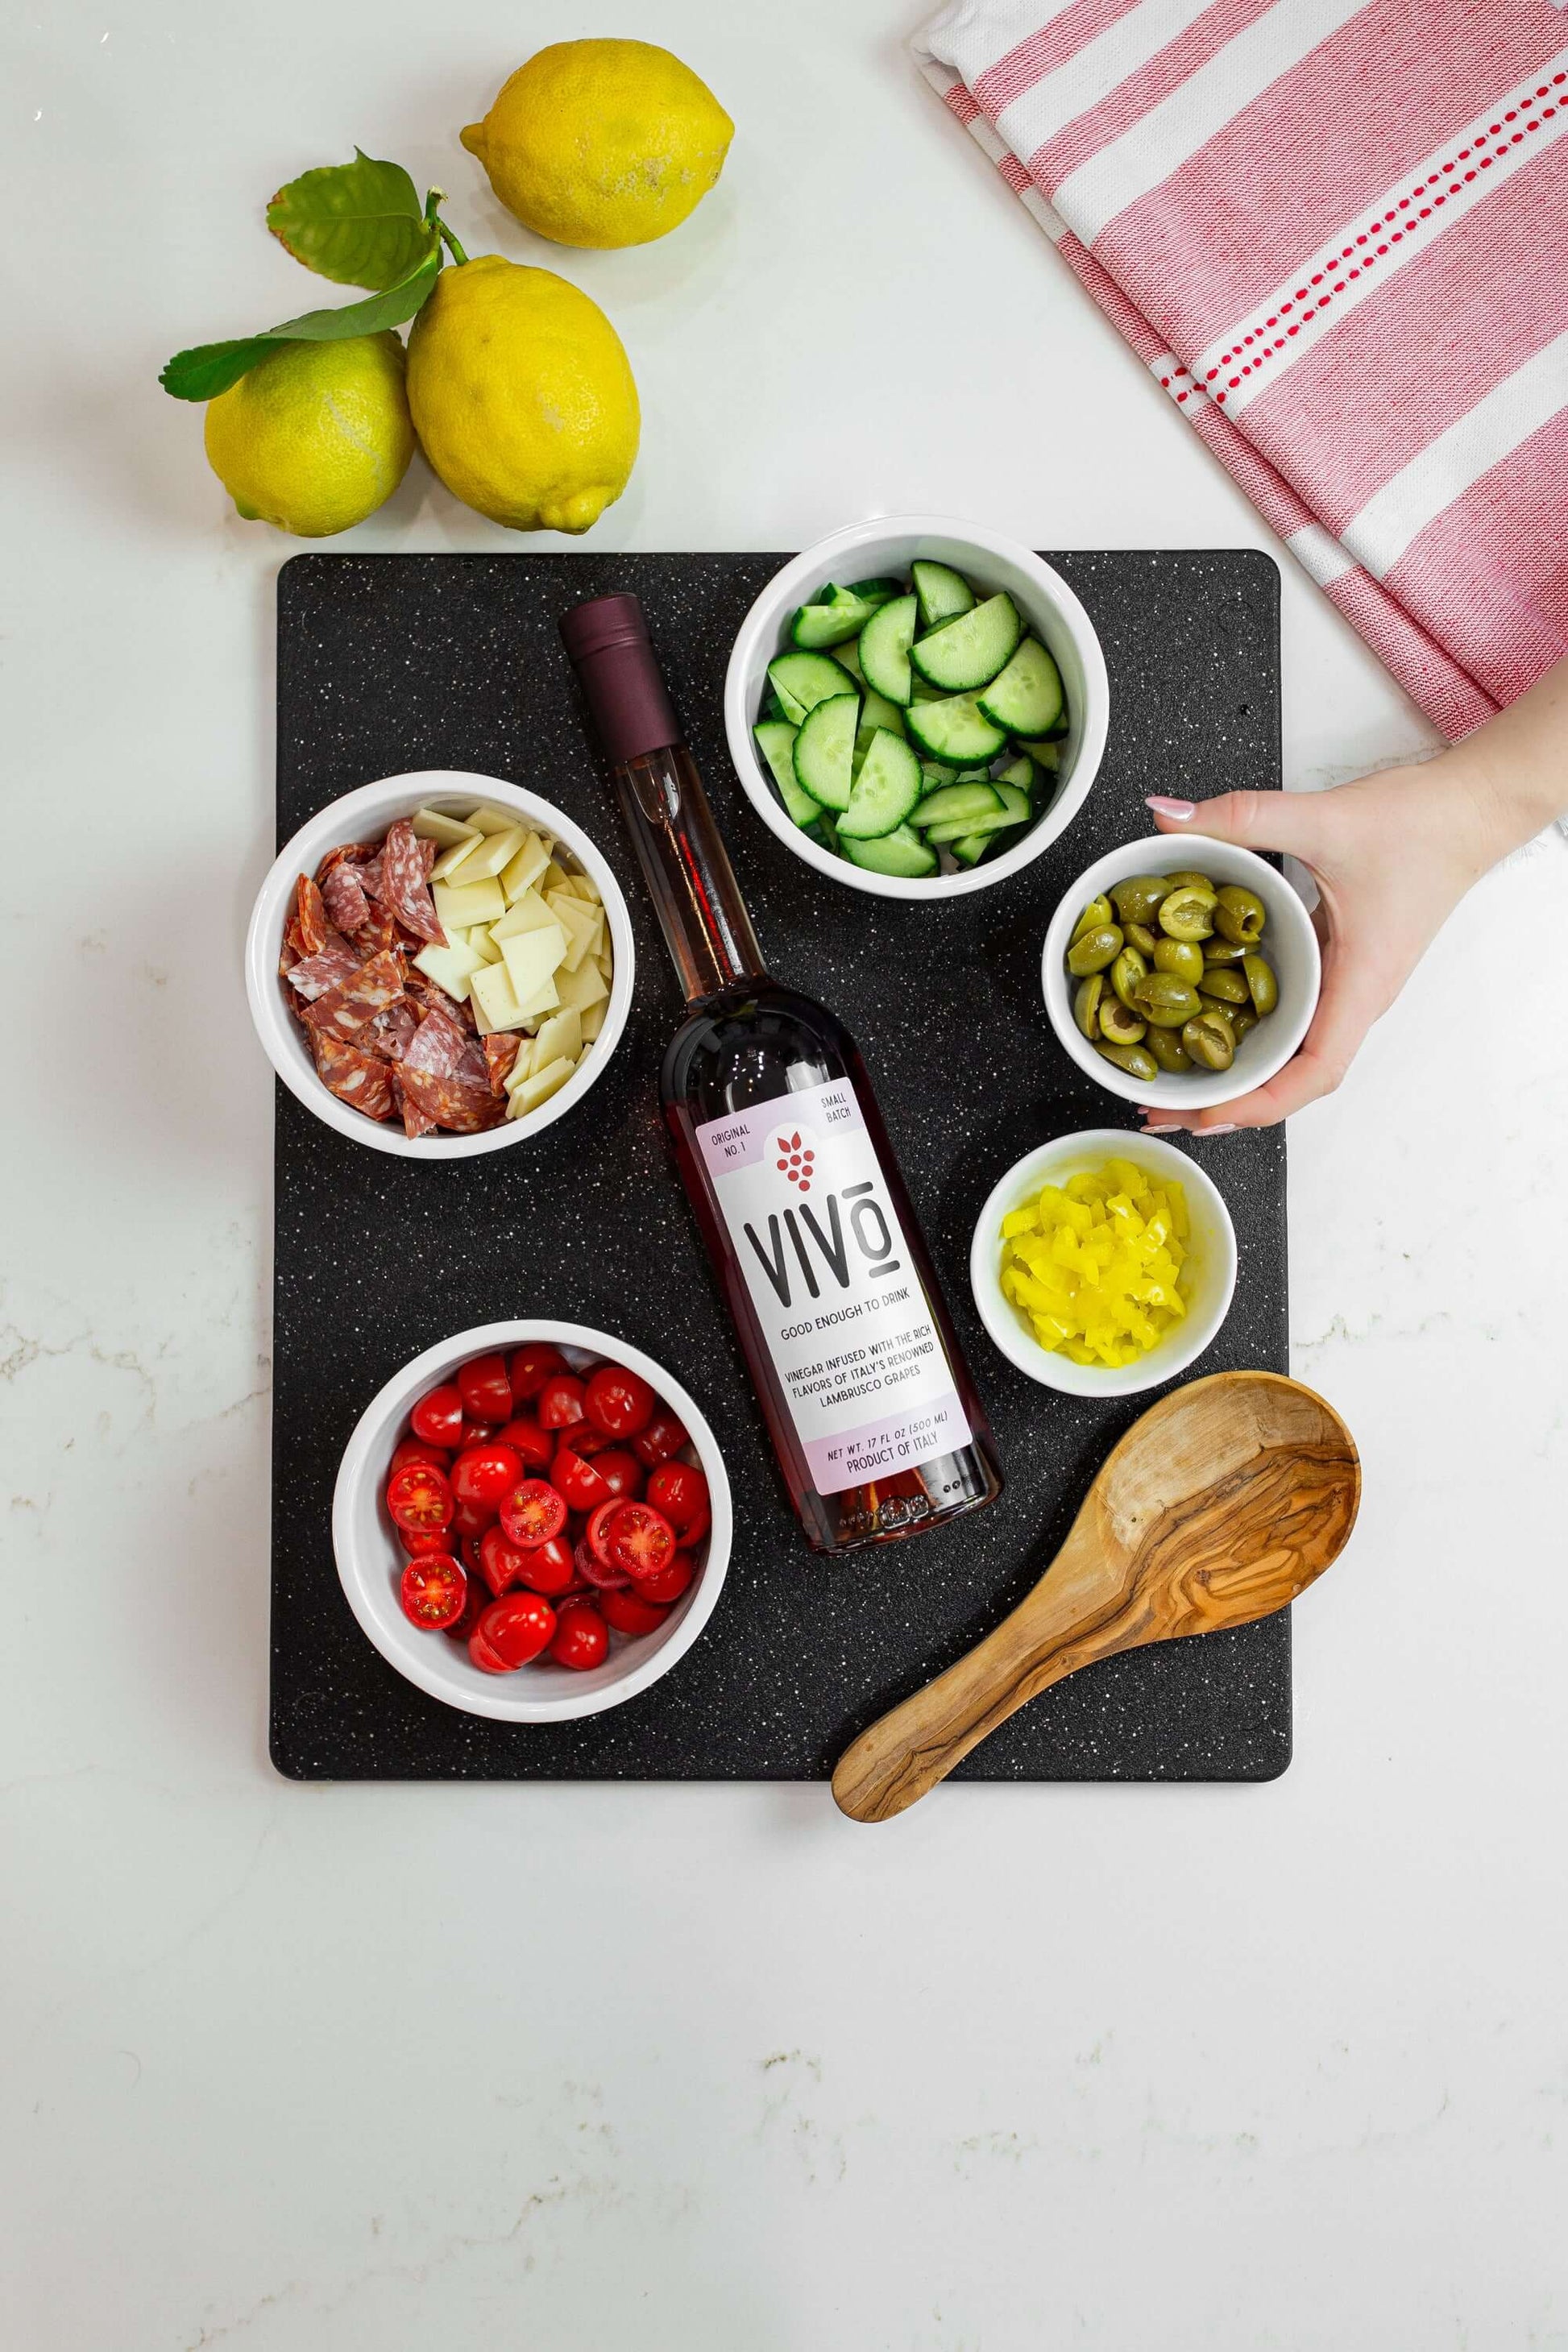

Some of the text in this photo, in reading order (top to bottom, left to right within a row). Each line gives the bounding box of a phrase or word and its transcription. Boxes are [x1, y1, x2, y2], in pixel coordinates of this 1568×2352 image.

[821, 1092, 847, 1109] SMALL
[827, 1106, 852, 1122] BATCH
[711, 1124, 750, 1146] ORIGINAL
[781, 1287, 911, 1340] GOOD ENOUGH TO DRINK
[784, 1324, 932, 1383] VINEGAR INFUSED WITH THE RICH
[792, 1341, 935, 1399] FLAVORS OF ITALY'S RENOWNED
[819, 1364, 921, 1408] LAMBRUSCO GRAPES
[828, 1448, 844, 1461] NET
[868, 1437, 877, 1450] 17
[881, 1434, 890, 1444] FL
[909, 1418, 931, 1435] (500
[934, 1411, 948, 1425] ML)
[846, 1431, 939, 1473] PRODUCT OF ITALY
